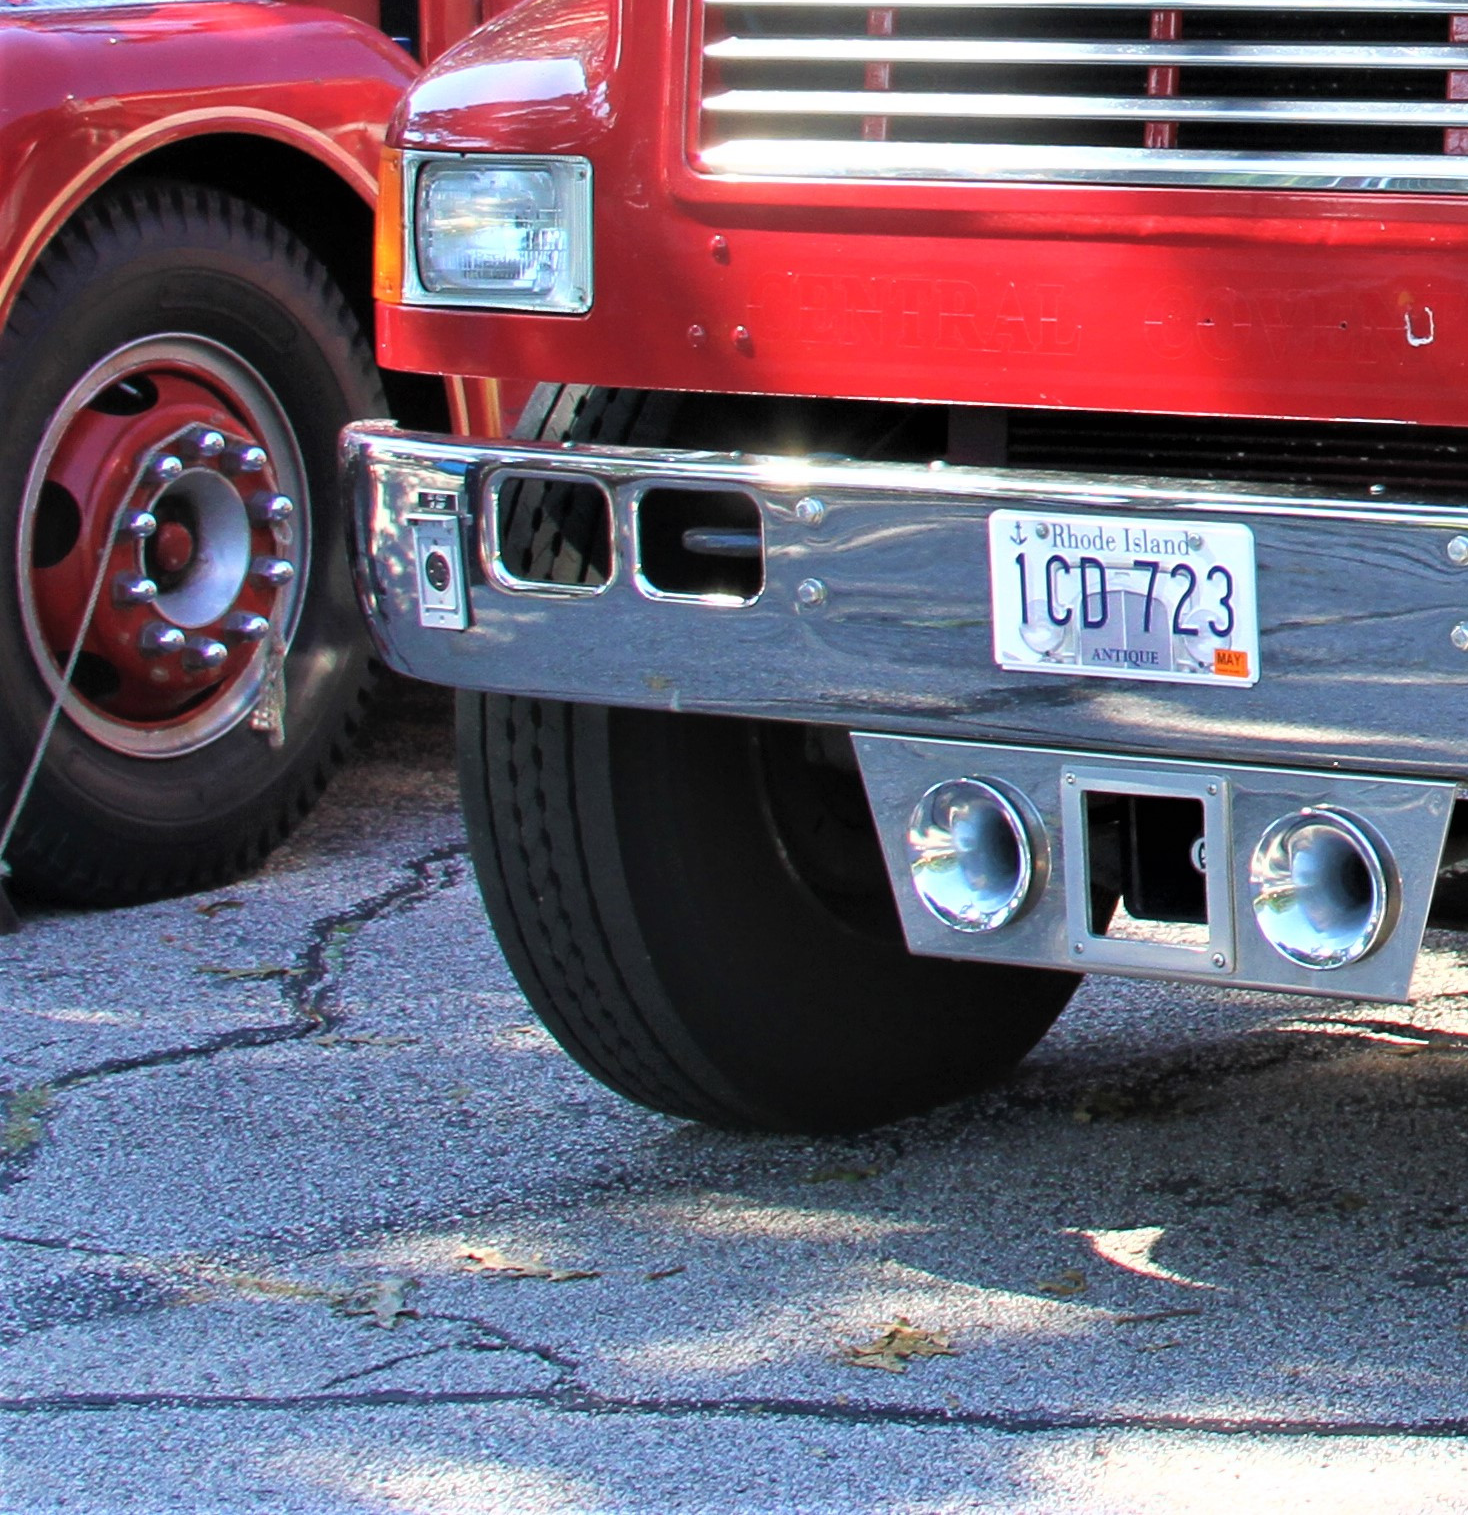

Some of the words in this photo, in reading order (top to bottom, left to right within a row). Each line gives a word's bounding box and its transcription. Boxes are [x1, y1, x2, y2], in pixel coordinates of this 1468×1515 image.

[1051, 522, 1118, 553] Rhode
[1124, 527, 1191, 557] Island
[1015, 552, 1108, 630] 1CD
[1133, 560, 1235, 638] 723
[1091, 647, 1160, 668] ANTIQUE
[1216, 651, 1241, 666] MAY
